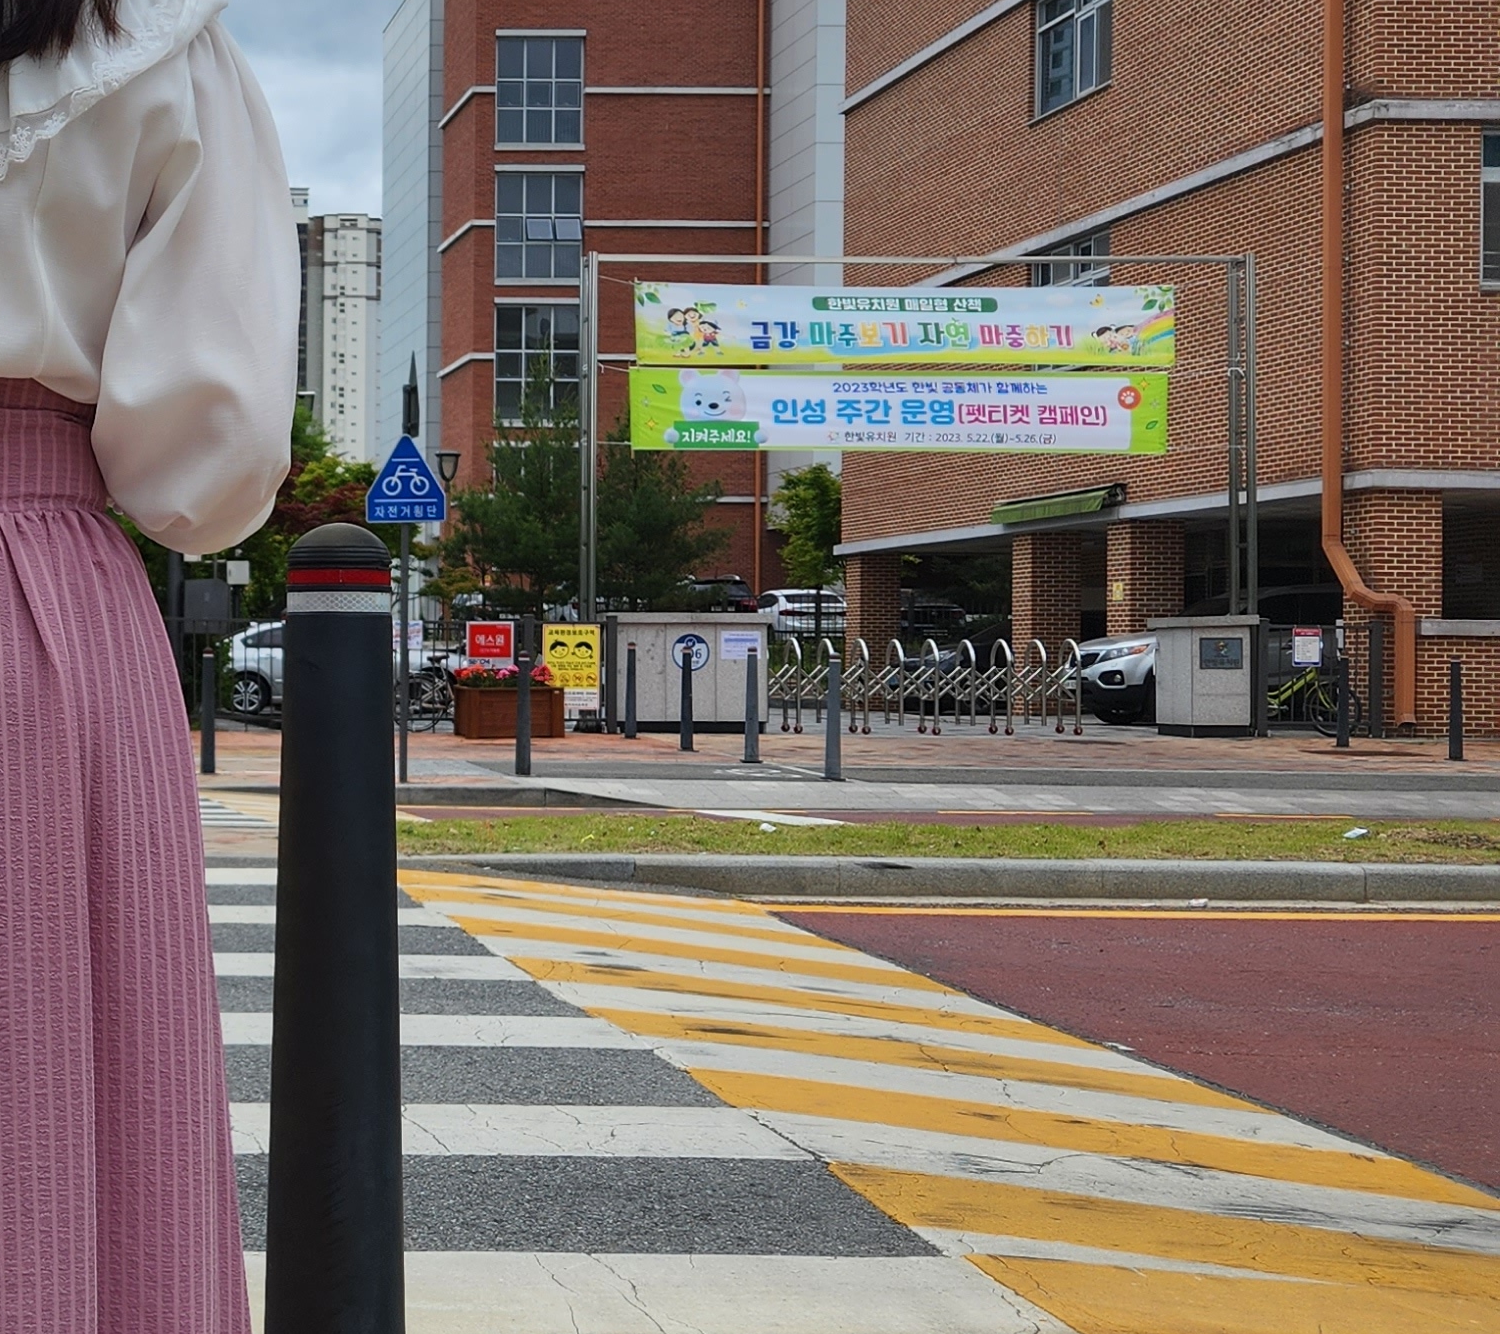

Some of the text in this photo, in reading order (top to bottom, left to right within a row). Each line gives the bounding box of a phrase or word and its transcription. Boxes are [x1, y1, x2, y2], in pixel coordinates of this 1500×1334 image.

[827, 297, 900, 311] 한빛유치원
[953, 298, 983, 312] 산책
[749, 318, 1074, 350] 금강 마주보기 자연 마중하기
[832, 381, 1048, 394] 2023학년도 한빛 공동체가 함께하는
[772, 398, 826, 425] 인성
[836, 398, 892, 424] 주간
[901, 398, 955, 425] 운영
[1037, 404, 1108, 427] 캠페인)
[681, 428, 751, 444] 지켜주세요!
[844, 430, 897, 443] 한빛유치원
[904, 432, 926, 444] 기간
[374, 504, 437, 518] 자전거횡단
[474, 634, 505, 646] 에스원
